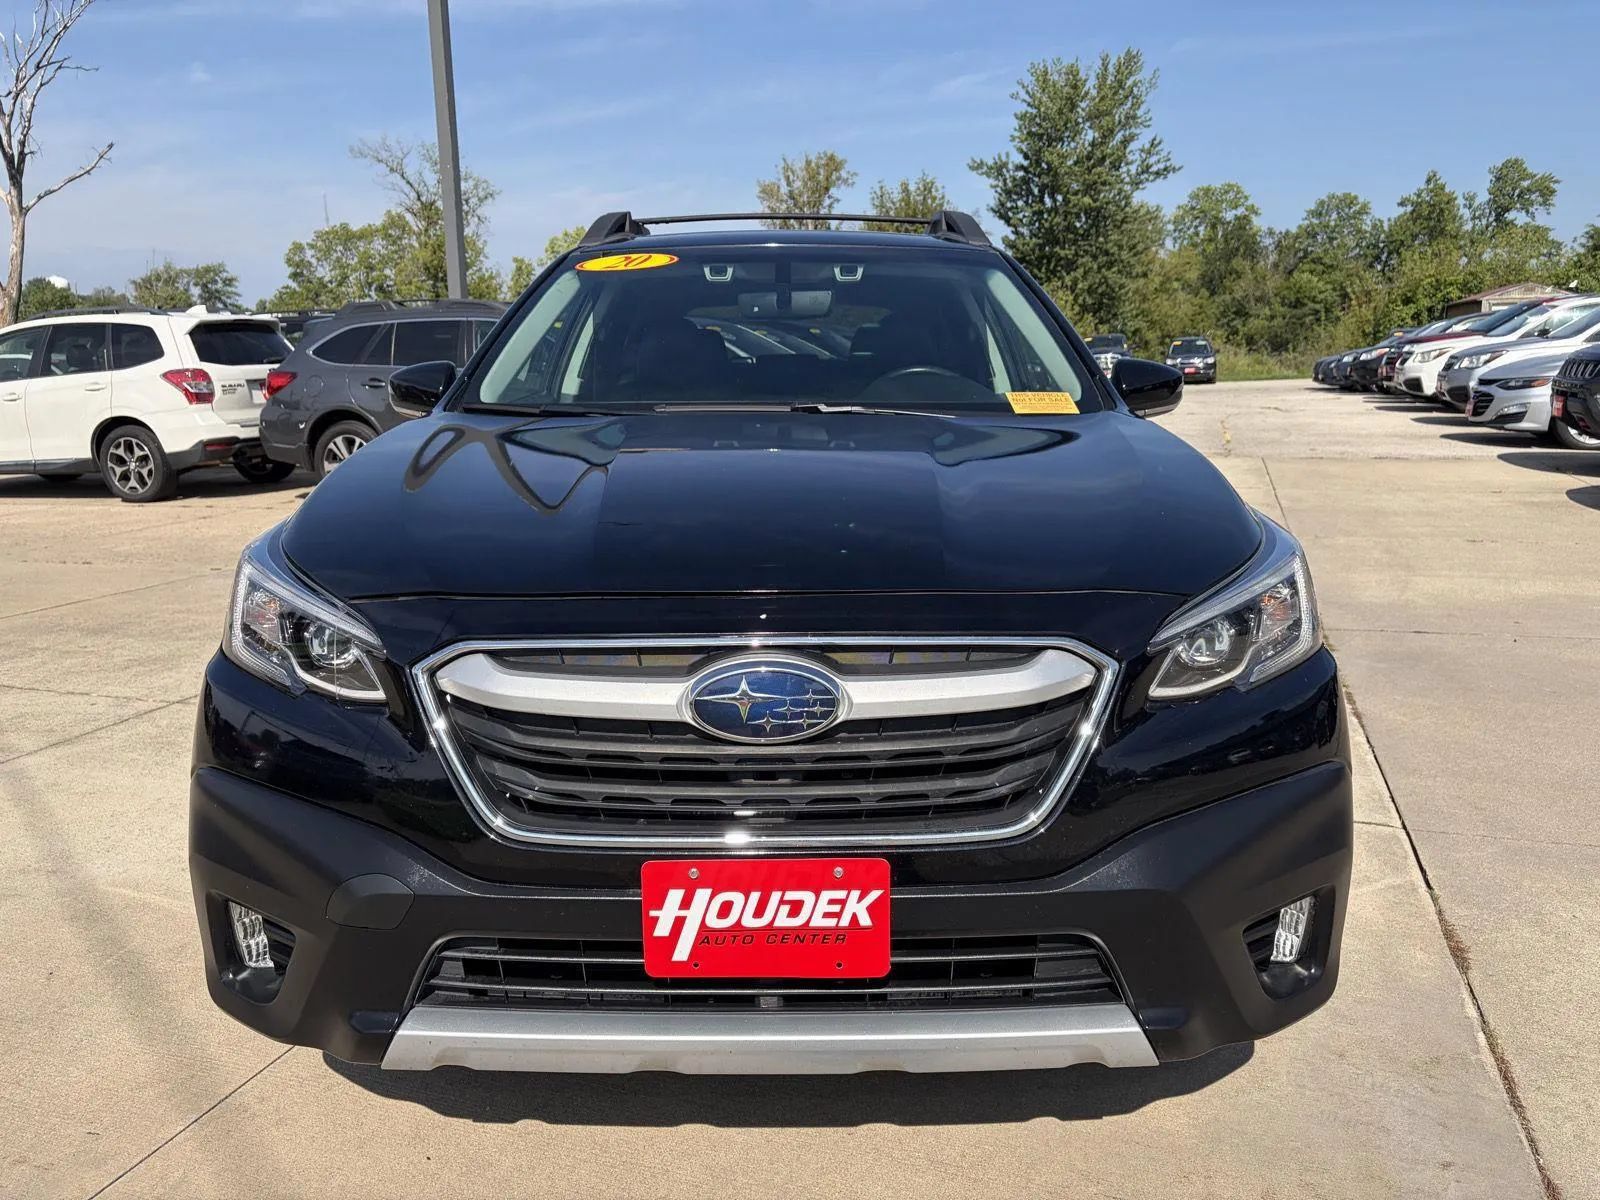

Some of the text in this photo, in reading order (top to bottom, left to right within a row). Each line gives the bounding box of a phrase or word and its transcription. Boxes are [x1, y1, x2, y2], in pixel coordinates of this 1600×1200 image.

[601, 255, 653, 269] 20
[649, 888, 885, 962] HOUDEK
[699, 933, 848, 946] AUTO CENTER
